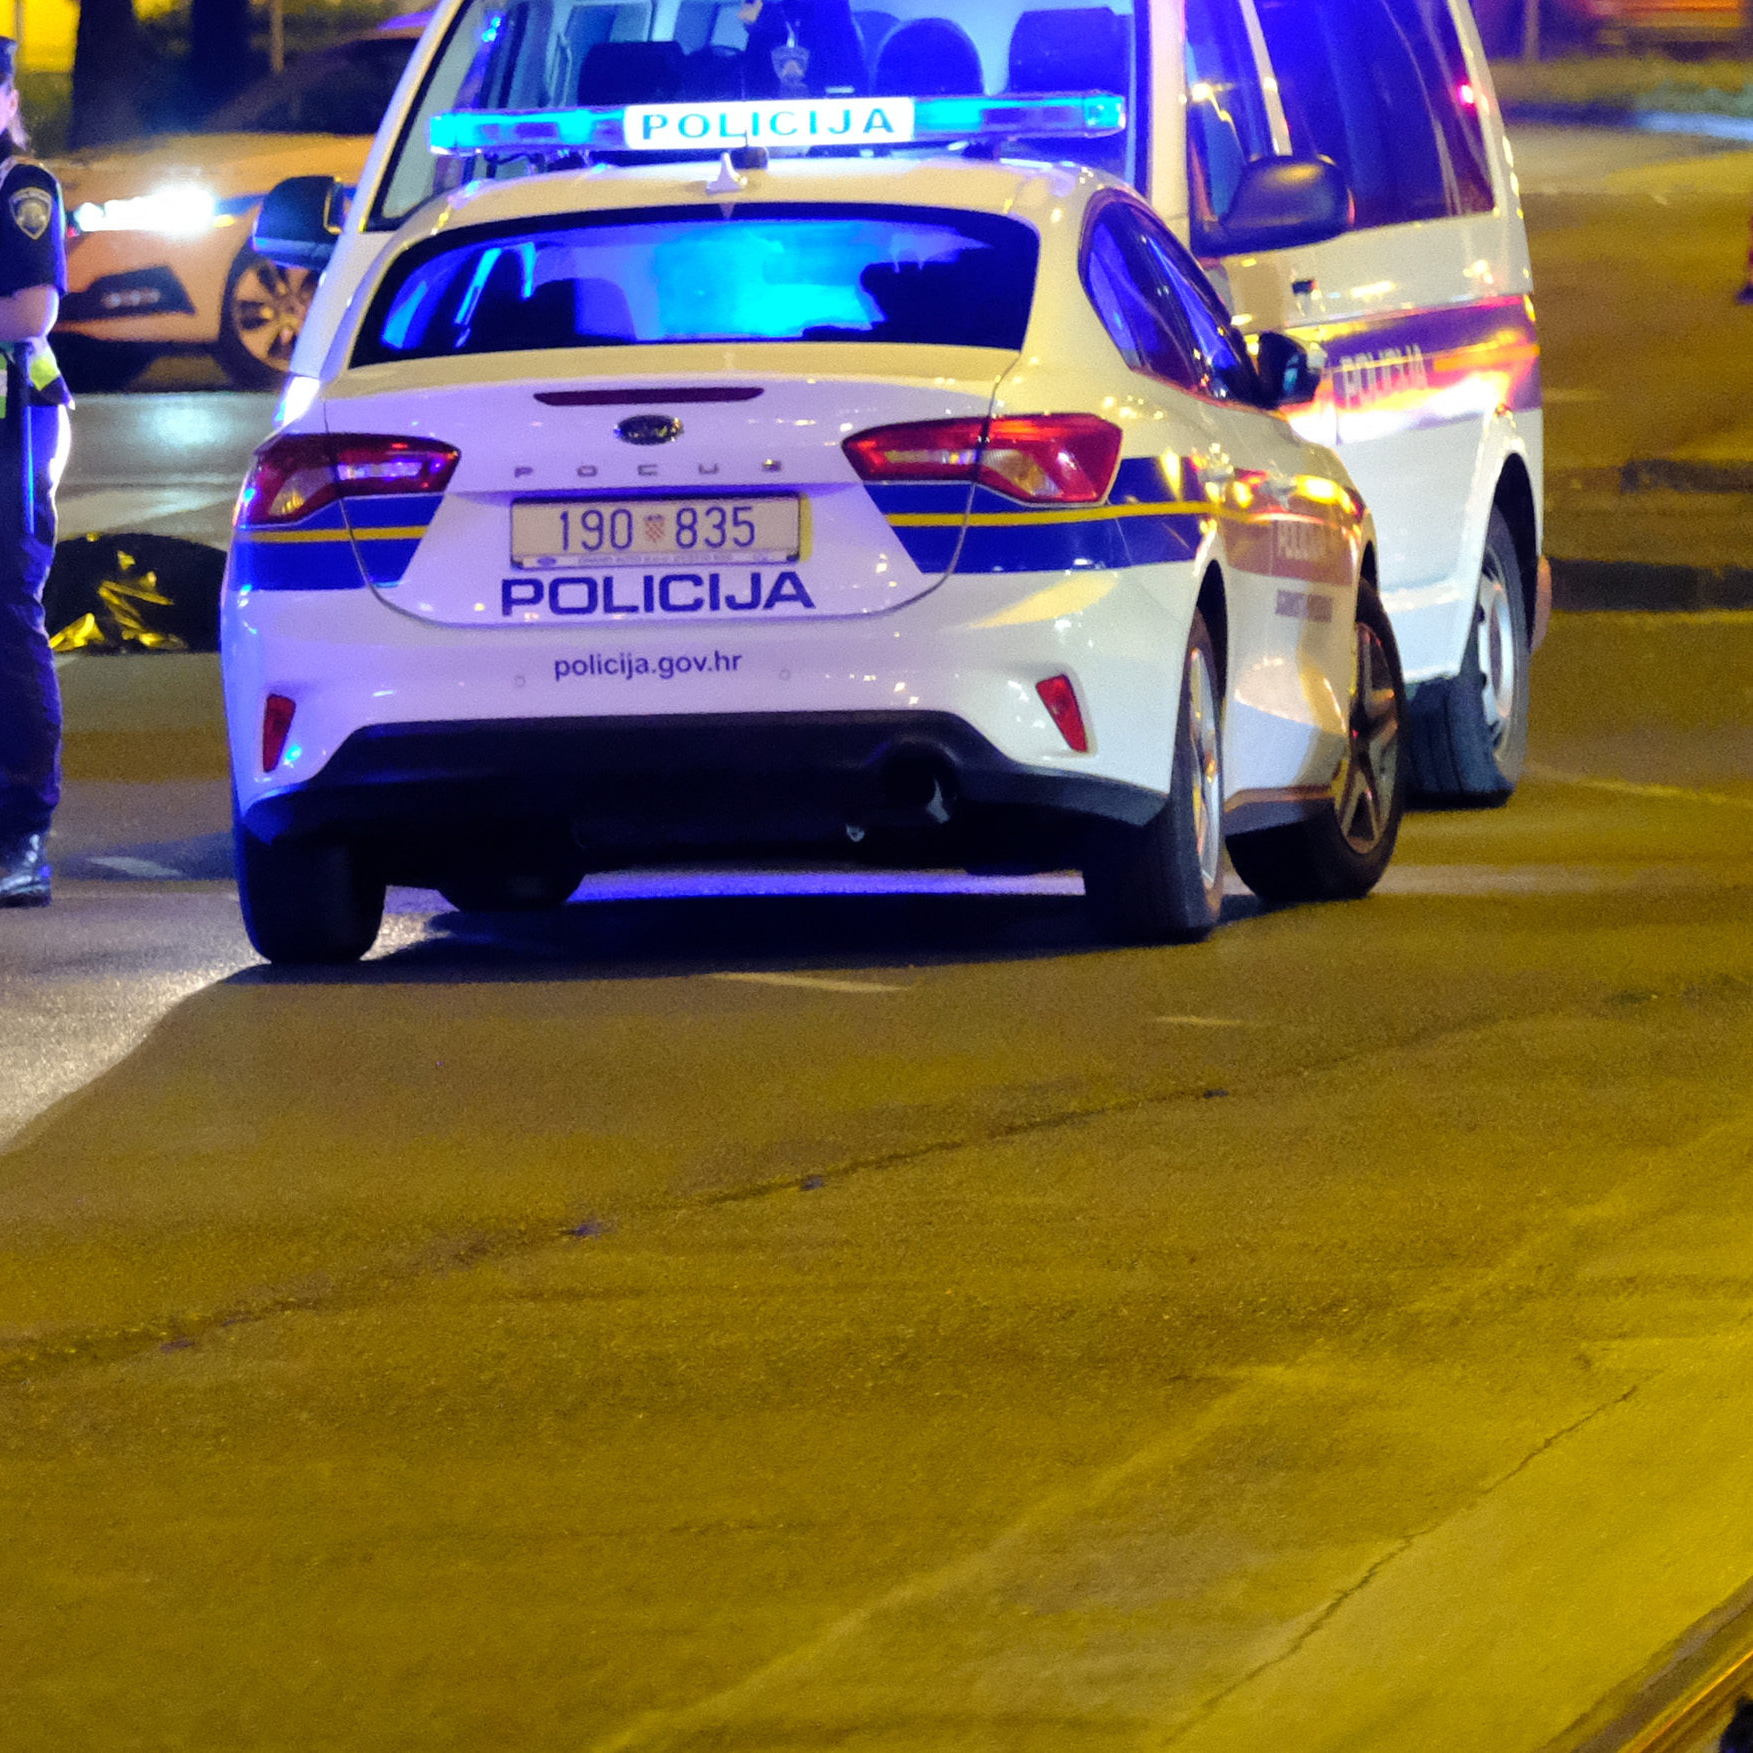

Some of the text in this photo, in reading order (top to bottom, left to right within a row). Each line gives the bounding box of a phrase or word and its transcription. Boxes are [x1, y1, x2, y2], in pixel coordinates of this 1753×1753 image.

[642, 107, 894, 140] POLICIJA
[560, 506, 756, 552] 190 835
[501, 570, 817, 617] POLICIJA
[554, 650, 743, 681] policija.gov.hr
